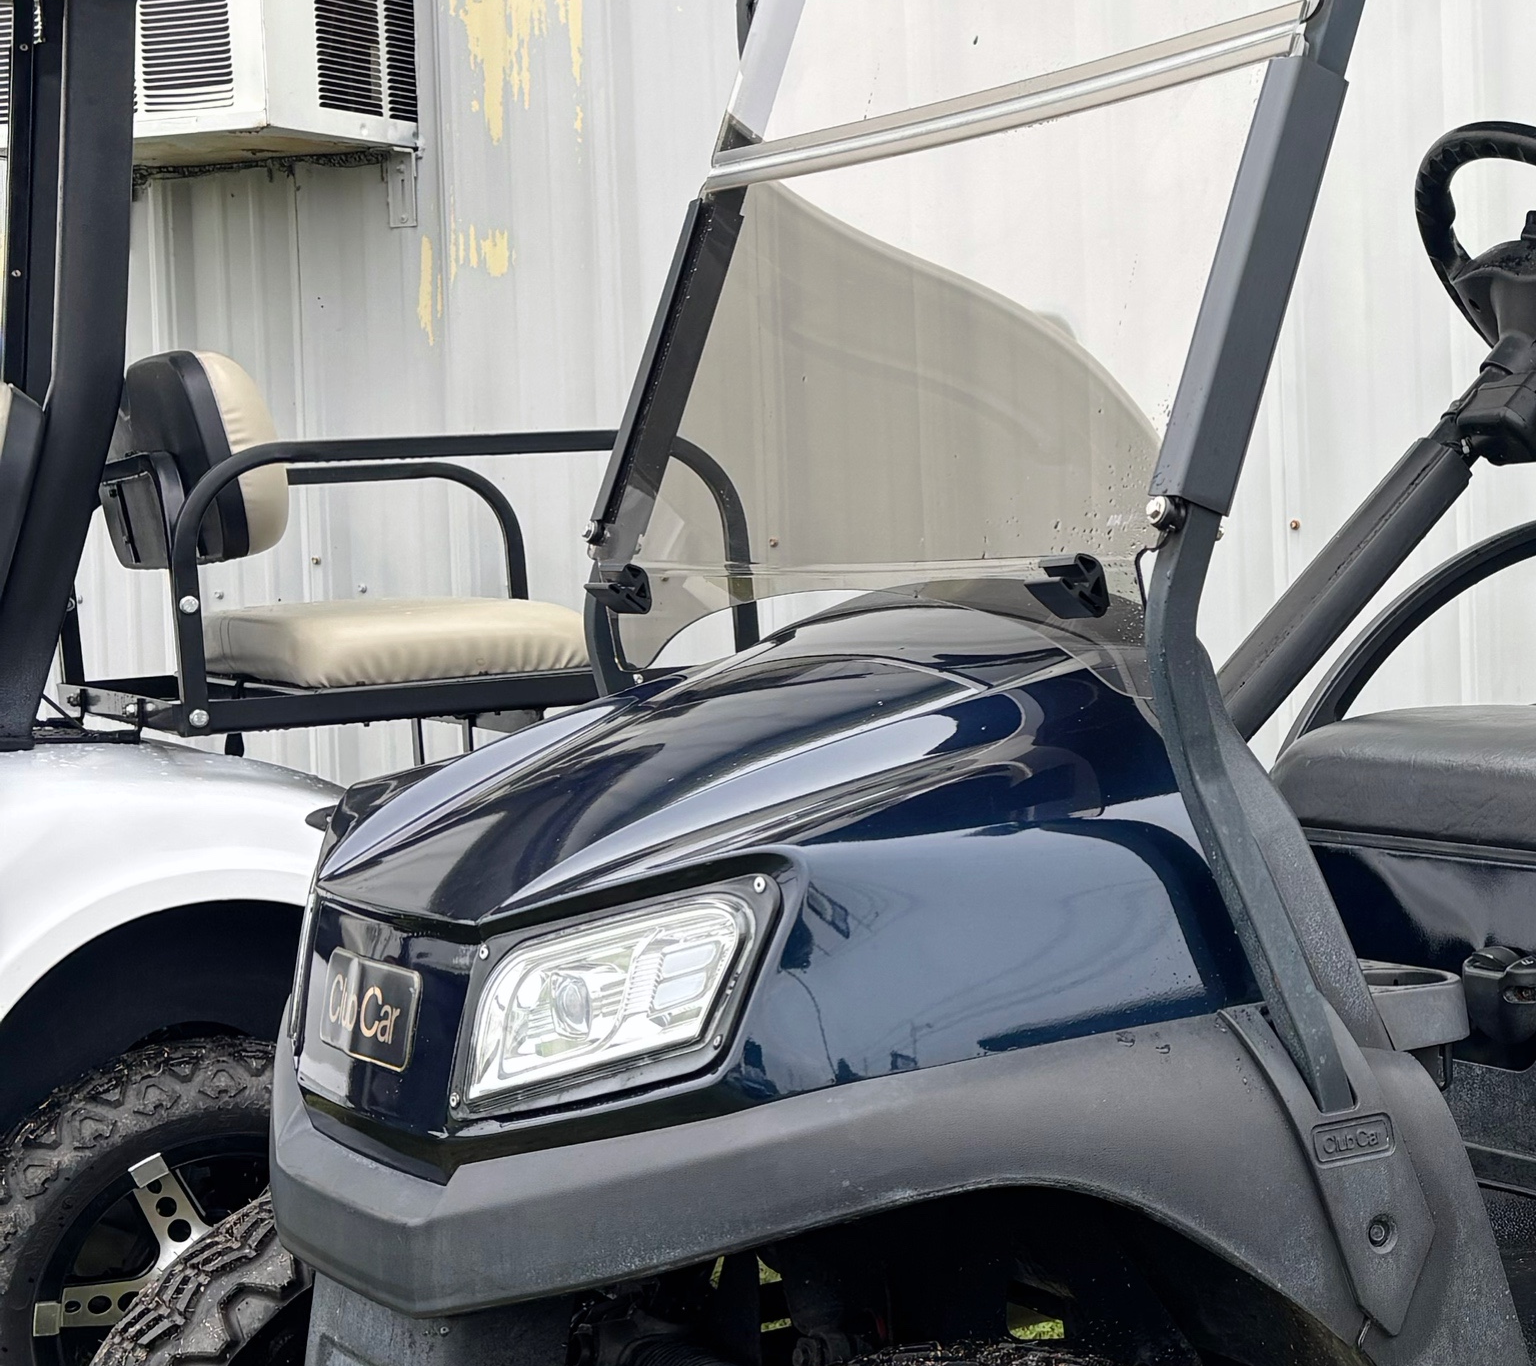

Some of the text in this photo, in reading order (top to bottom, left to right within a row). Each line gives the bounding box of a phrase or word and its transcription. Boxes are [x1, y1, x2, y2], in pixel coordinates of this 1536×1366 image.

[329, 972, 401, 1045] Club Car
[1322, 1128, 1381, 1154] Club Car
